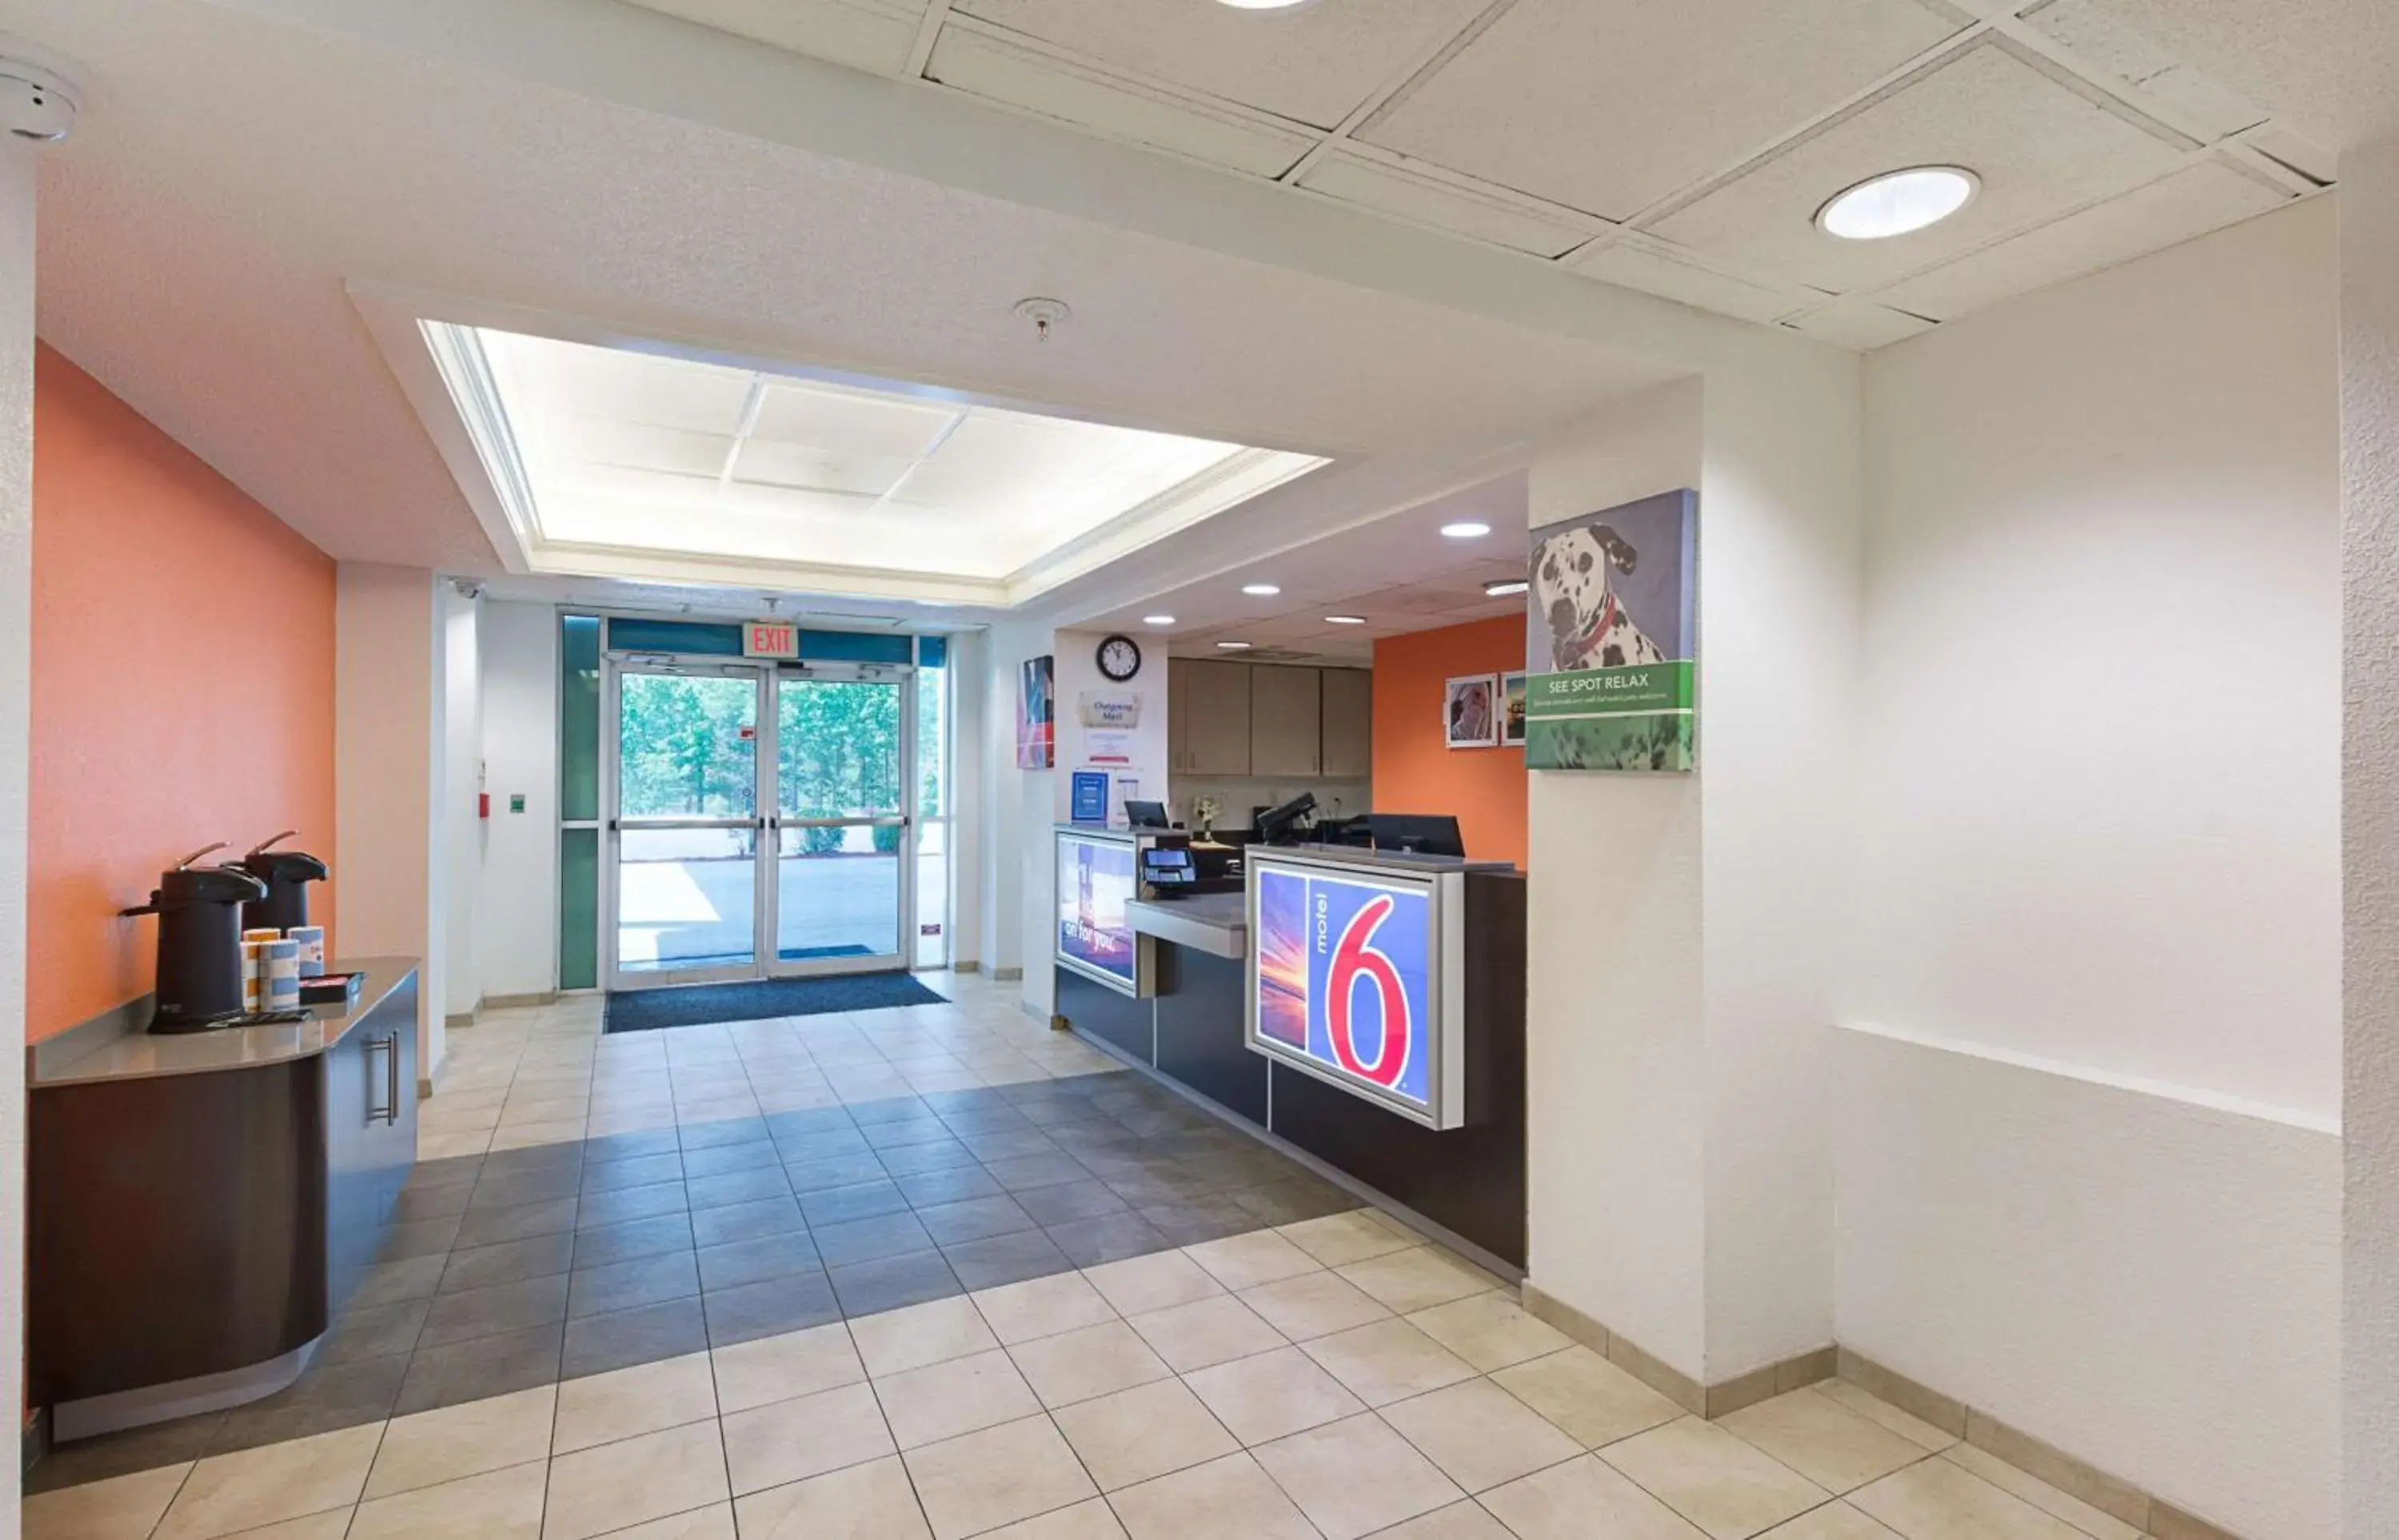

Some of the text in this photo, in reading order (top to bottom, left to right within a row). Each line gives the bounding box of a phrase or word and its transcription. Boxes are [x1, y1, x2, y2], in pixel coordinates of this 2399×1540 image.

[753, 626, 790, 652] EXIT
[1549, 672, 1650, 694] SEE SPOT RELAX
[1094, 700, 1132, 713] Outgoing
[1103, 712, 1123, 721] Mail
[1079, 920, 1093, 944] for
[1315, 893, 1327, 955] motel
[1325, 894, 1412, 1091] 6
